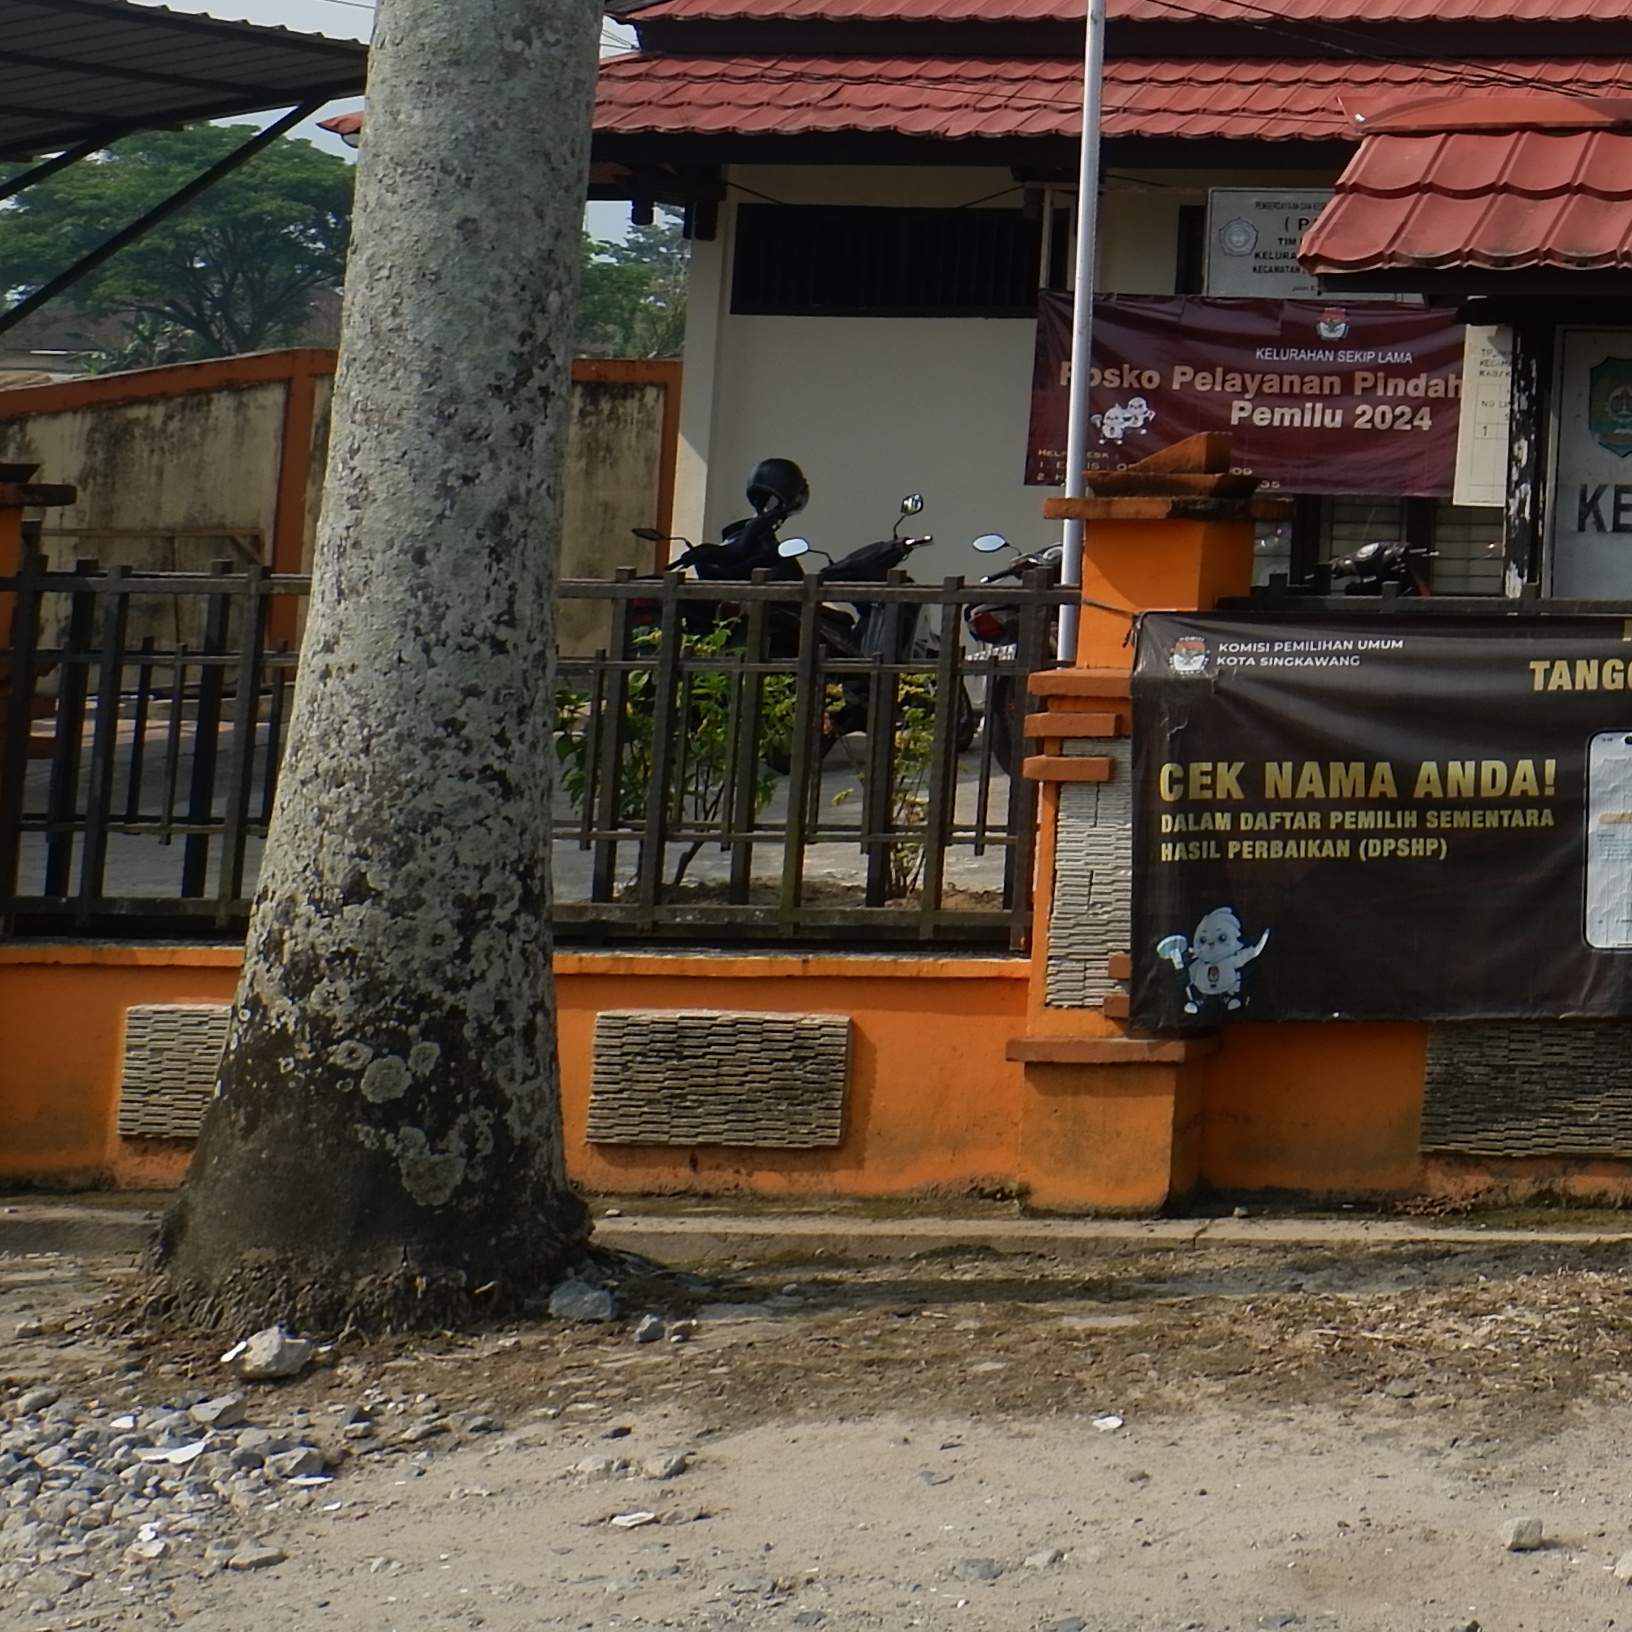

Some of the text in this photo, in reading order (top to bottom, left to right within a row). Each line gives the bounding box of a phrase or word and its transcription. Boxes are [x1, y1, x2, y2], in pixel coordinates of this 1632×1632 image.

[1278, 237, 1296, 246] TIM
[1254, 251, 1297, 260] KELURA
[1256, 347, 1413, 364] KELURAHAN SEKIP LAMA
[1172, 365, 1342, 399] Pelayanan
[1354, 370, 1463, 399] Pindah
[1230, 400, 1433, 432] Pemilu 2024
[1218, 639, 1404, 653] KOMISI PEMILIHAN UMUM
[1216, 655, 1361, 667] KOTA SINGKAWANG
[1159, 759, 1557, 802] CEK NAMA ANDA!
[1160, 808, 1555, 834] DALAM DAFTAR PEMILIH SEMENTARA
[1160, 837, 1448, 862] HASIL PERBAIKAN (DPSHP)
